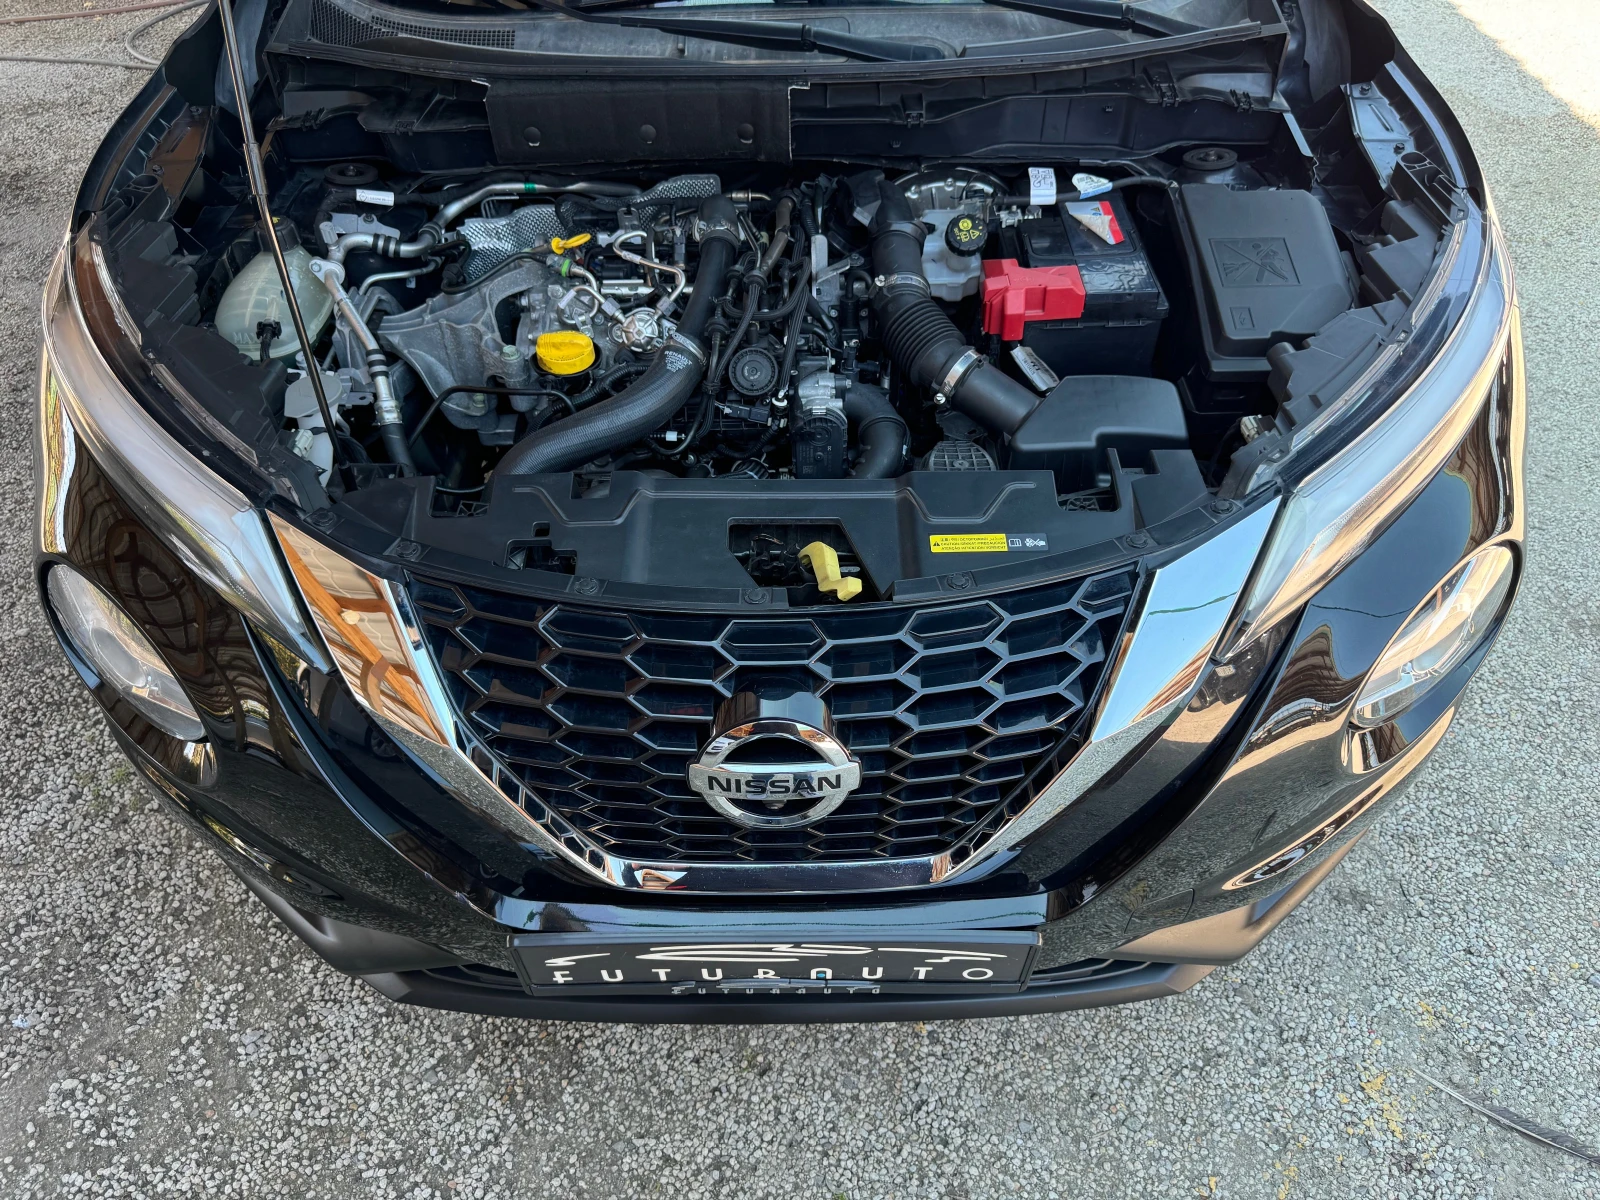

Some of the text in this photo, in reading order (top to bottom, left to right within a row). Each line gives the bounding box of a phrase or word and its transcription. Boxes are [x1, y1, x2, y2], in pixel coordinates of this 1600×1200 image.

[664, 350, 693, 366] RENAULT
[708, 774, 841, 795] NISSAN
[552, 966, 994, 983] FUTURAUTO
